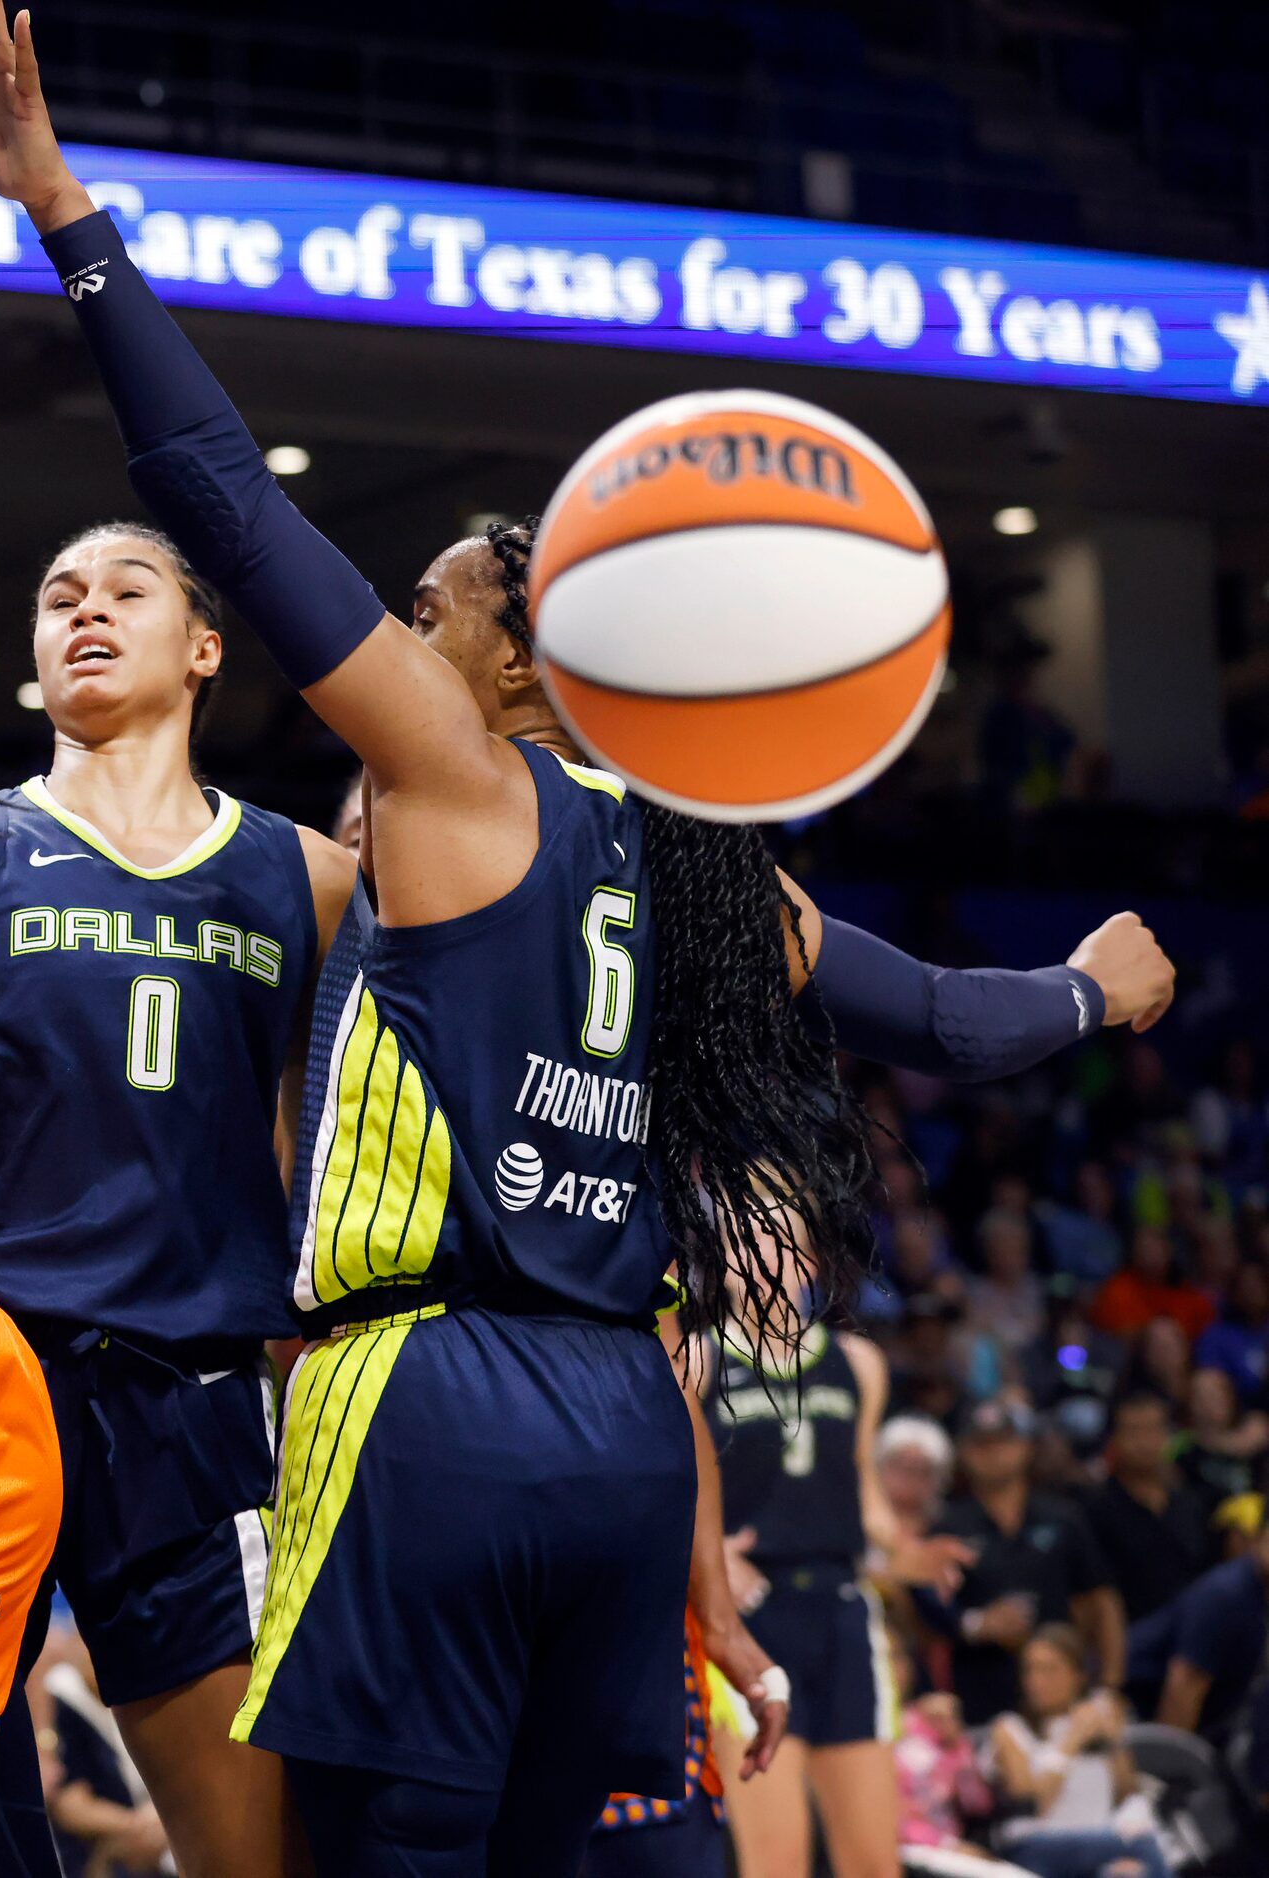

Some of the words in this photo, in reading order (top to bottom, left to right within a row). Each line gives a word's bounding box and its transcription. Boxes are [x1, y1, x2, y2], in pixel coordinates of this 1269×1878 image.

[299, 205, 401, 300] of
[409, 213, 663, 325] Texas
[680, 237, 806, 338] for
[824, 259, 923, 349] 30
[940, 267, 1161, 372] Years
[588, 431, 861, 507] Wilson
[10, 905, 283, 987] DALLAS
[581, 885, 636, 1059] 6
[126, 974, 181, 1092] 0
[514, 1051, 654, 1146] THORNTON
[543, 1171, 637, 1224] AT&T
